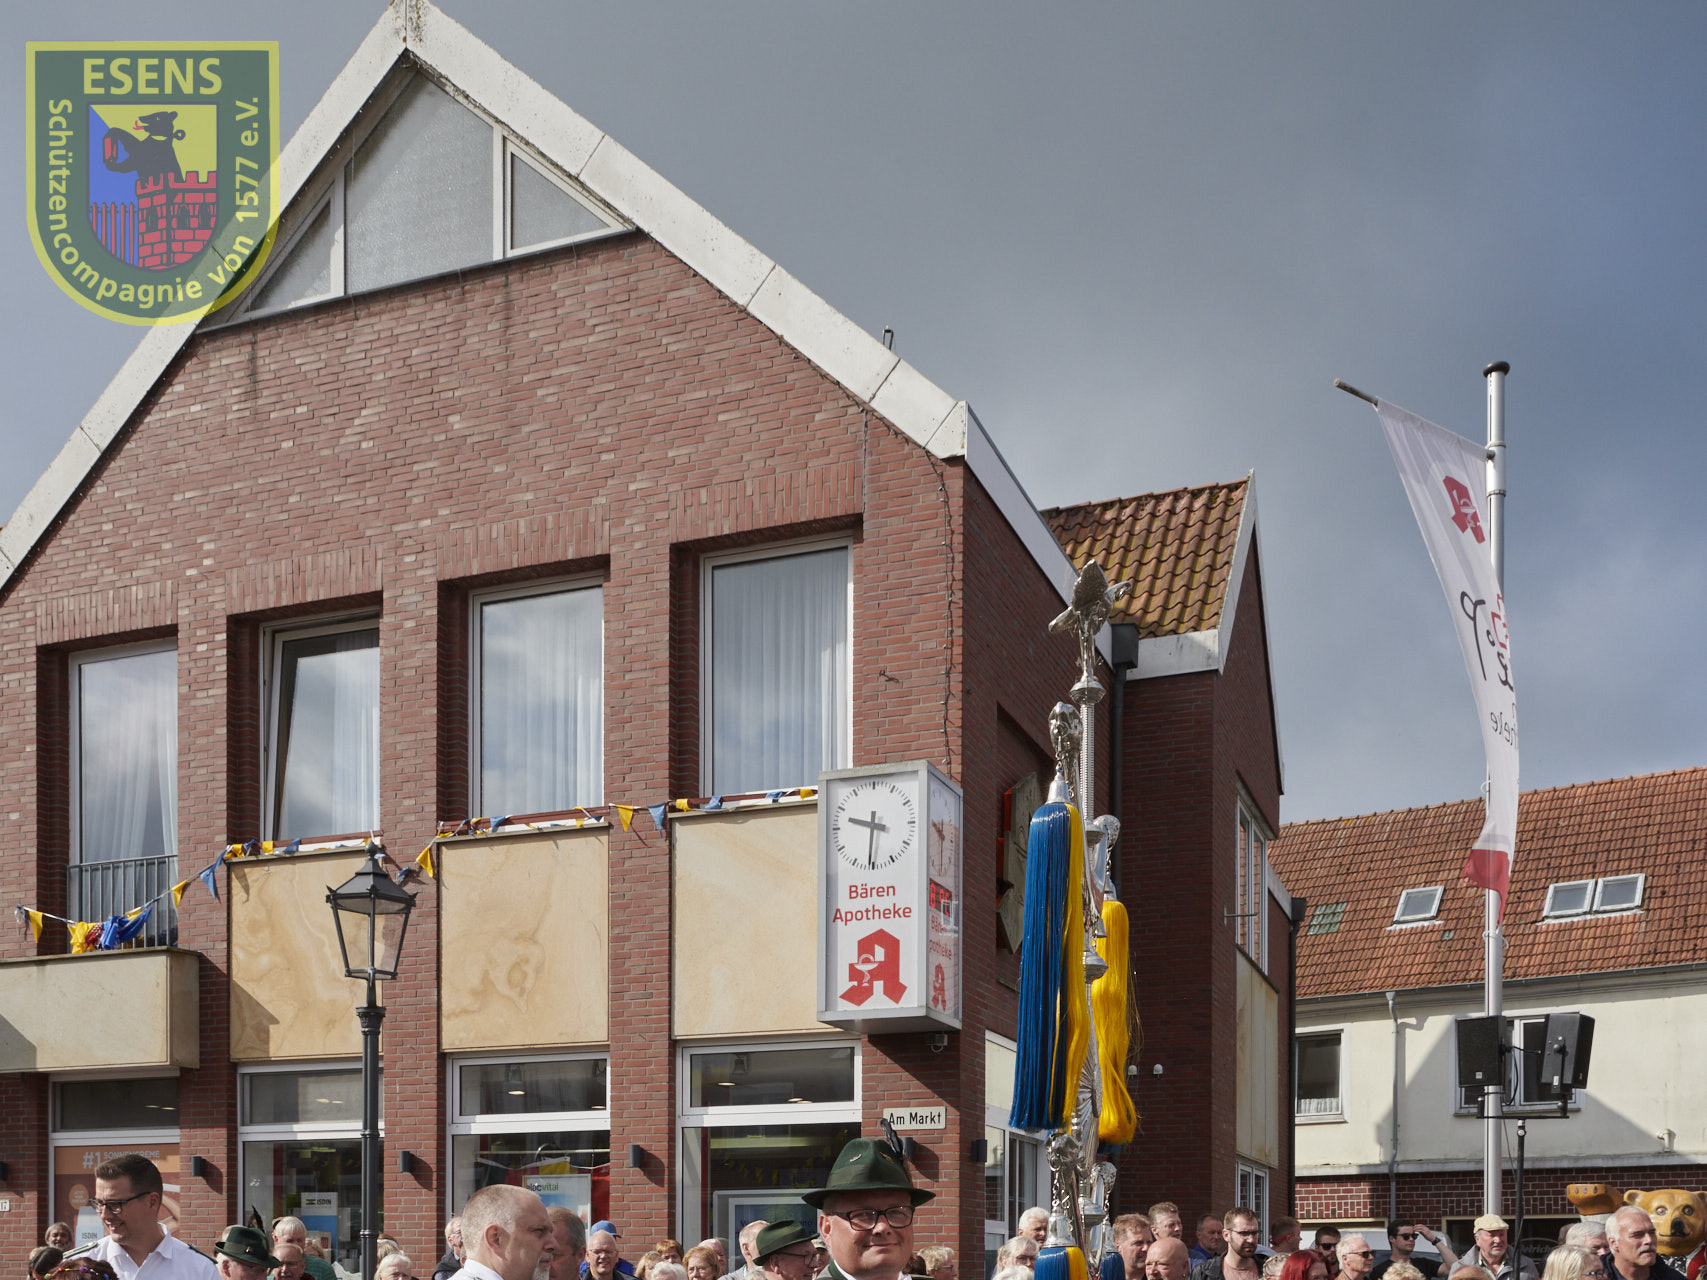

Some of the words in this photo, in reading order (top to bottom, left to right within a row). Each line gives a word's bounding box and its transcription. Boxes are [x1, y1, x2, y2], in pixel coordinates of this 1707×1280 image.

[848, 884, 896, 900] Bären
[832, 903, 912, 926] Apotheke
[929, 938, 953, 960] potheke
[889, 1112, 905, 1125] Am
[909, 1111, 942, 1125] Markt
[82, 1151, 101, 1169] #1
[316, 1198, 332, 1206] ISDIN
